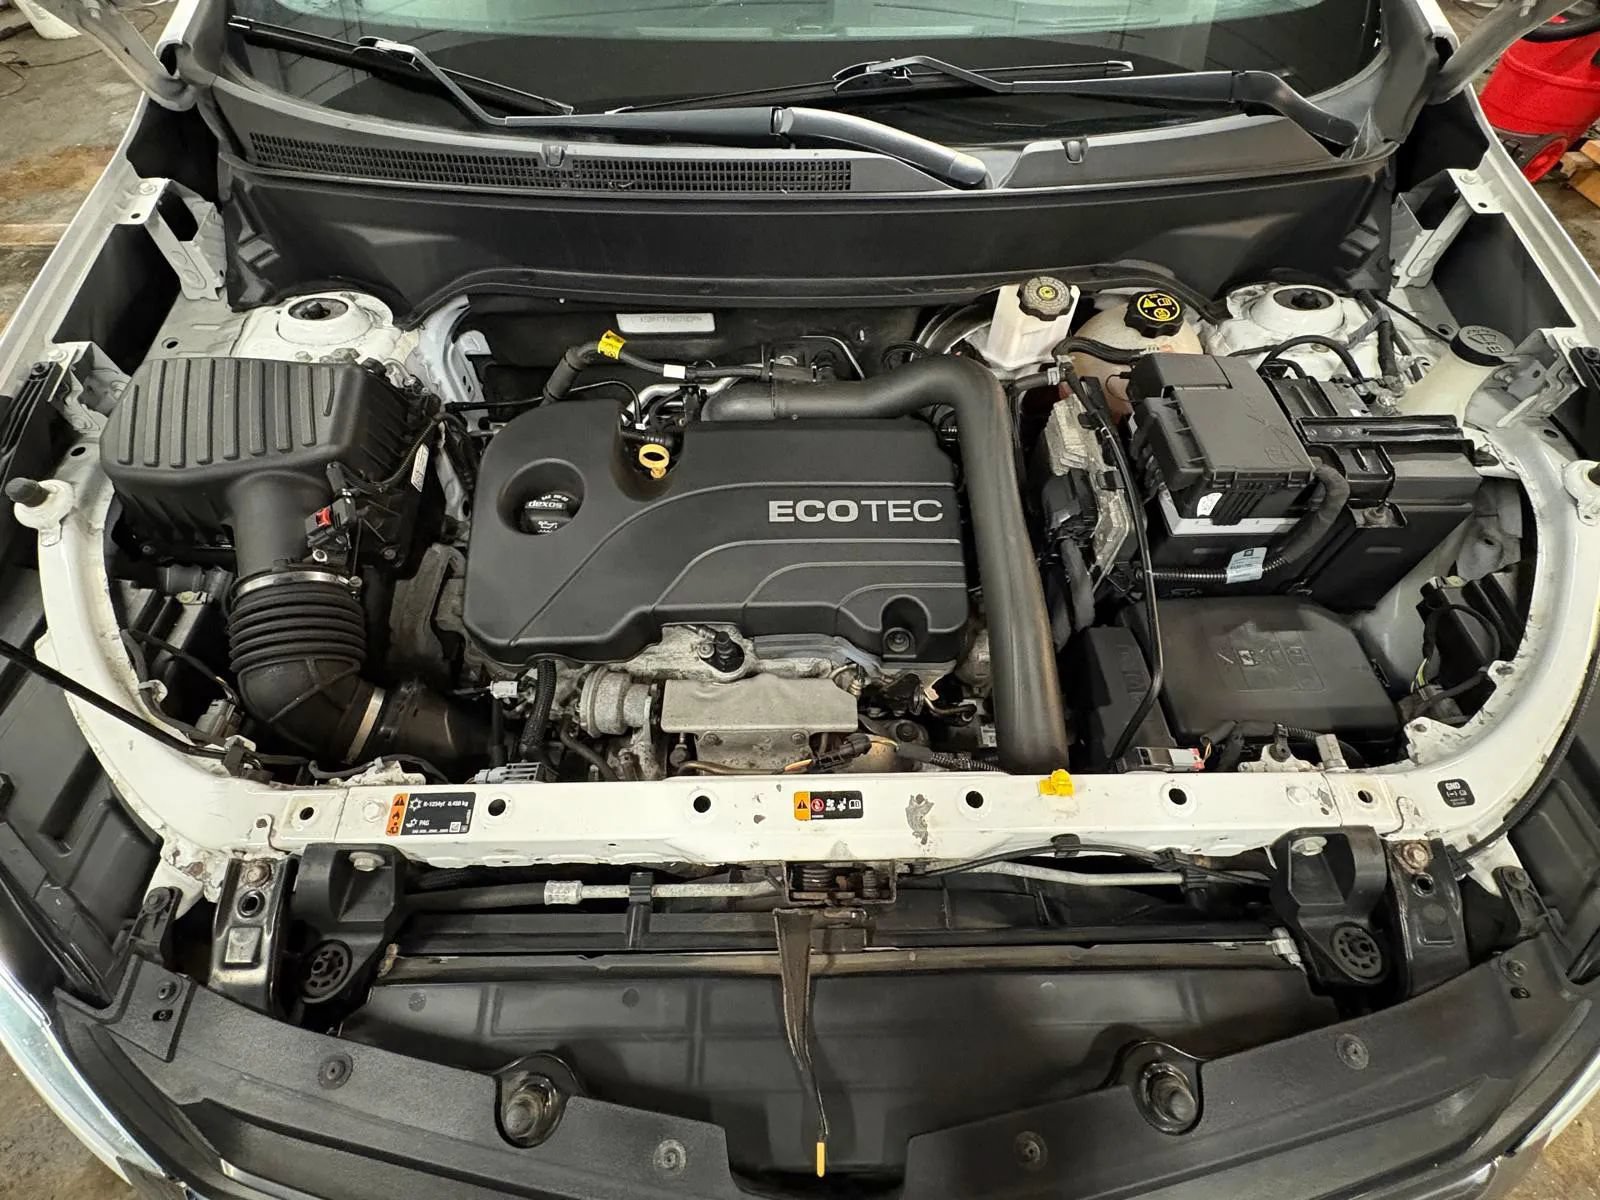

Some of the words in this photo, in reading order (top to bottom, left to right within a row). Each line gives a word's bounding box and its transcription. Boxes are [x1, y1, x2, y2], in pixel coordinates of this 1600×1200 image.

[528, 500, 563, 508] dexos
[768, 499, 944, 523] ECOTEC
[1445, 781, 1461, 790] GND
